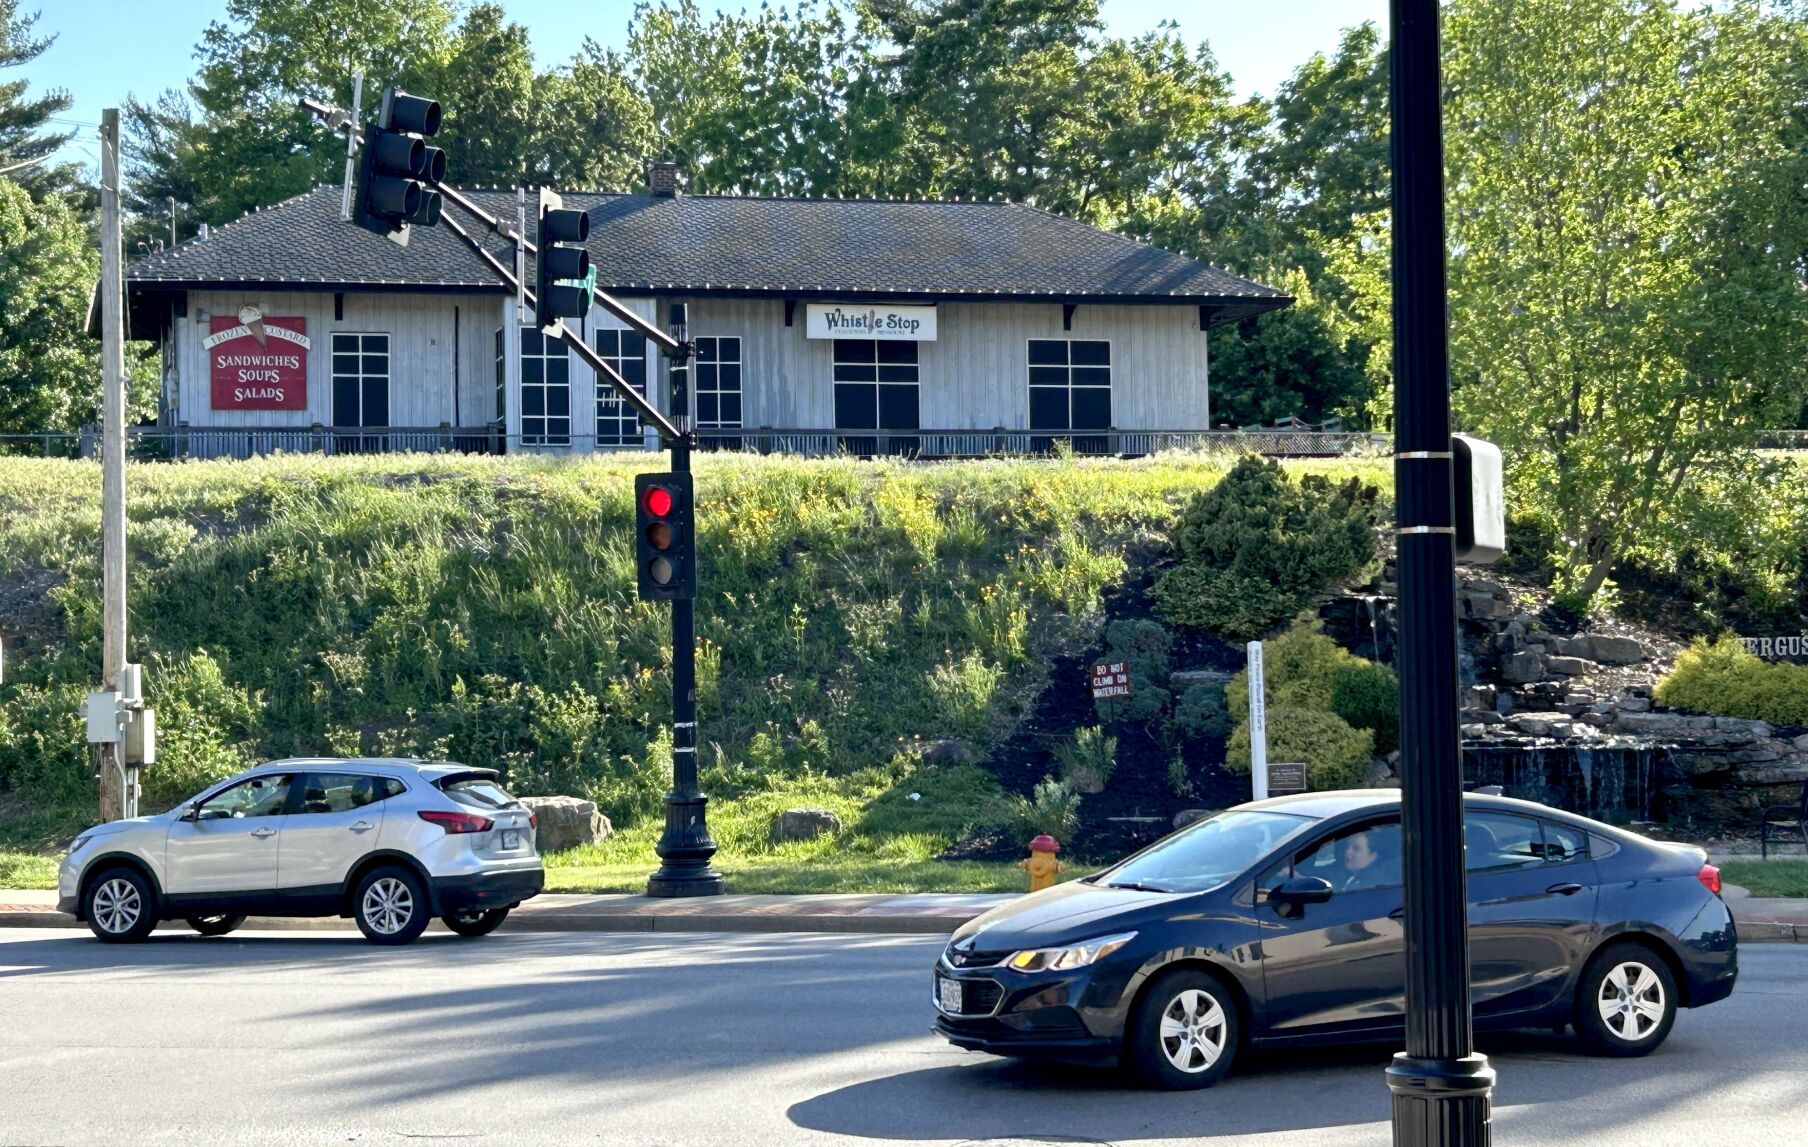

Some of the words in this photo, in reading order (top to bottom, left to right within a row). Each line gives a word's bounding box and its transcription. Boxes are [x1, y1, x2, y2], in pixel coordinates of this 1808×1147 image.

[824, 308, 883, 334] Whistle
[886, 314, 920, 334] Stop
[210, 327, 248, 344] FROZEN
[217, 355, 300, 369] SANDWICHES
[238, 369, 280, 383] SOUPS
[234, 388, 285, 402] SALADS
[1736, 636, 1808, 656] ERGUS
[1096, 665, 1107, 675] DO
[1110, 662, 1124, 673] NOT
[1093, 675, 1113, 687] CLIMB
[1117, 674, 1127, 683] ON
